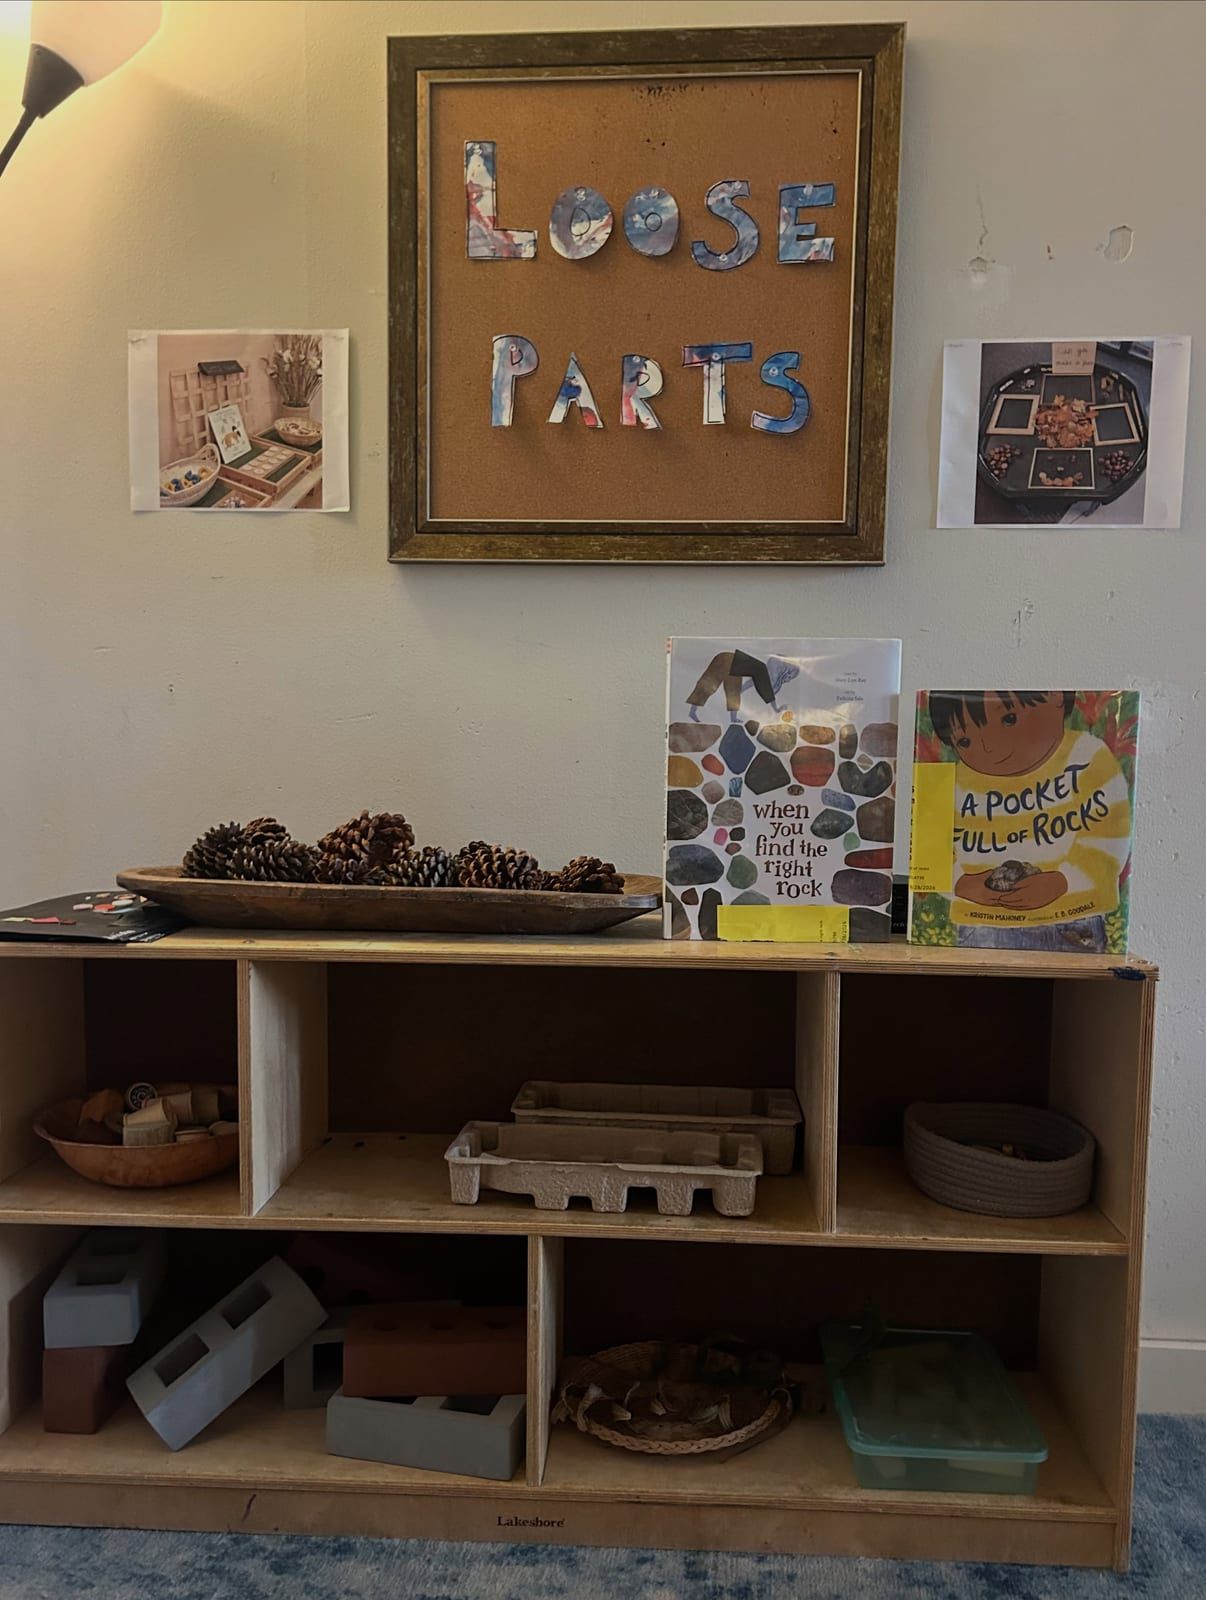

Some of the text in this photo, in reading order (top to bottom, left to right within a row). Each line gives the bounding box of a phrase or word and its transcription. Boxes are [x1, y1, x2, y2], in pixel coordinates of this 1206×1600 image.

[464, 140, 836, 271] LOOSE
[490, 334, 811, 435] PARTS
[961, 763, 1090, 821] A POCKET
[753, 800, 810, 819] when
[1007, 829, 1028, 843] OF
[1033, 790, 1109, 846] ROCKS
[770, 822, 804, 838] you
[755, 834, 828, 857] find the
[764, 860, 813, 878] right
[776, 879, 822, 898] rock
[970, 912, 994, 920] KRISTIN
[497, 1516, 565, 1528] Lakeshore
